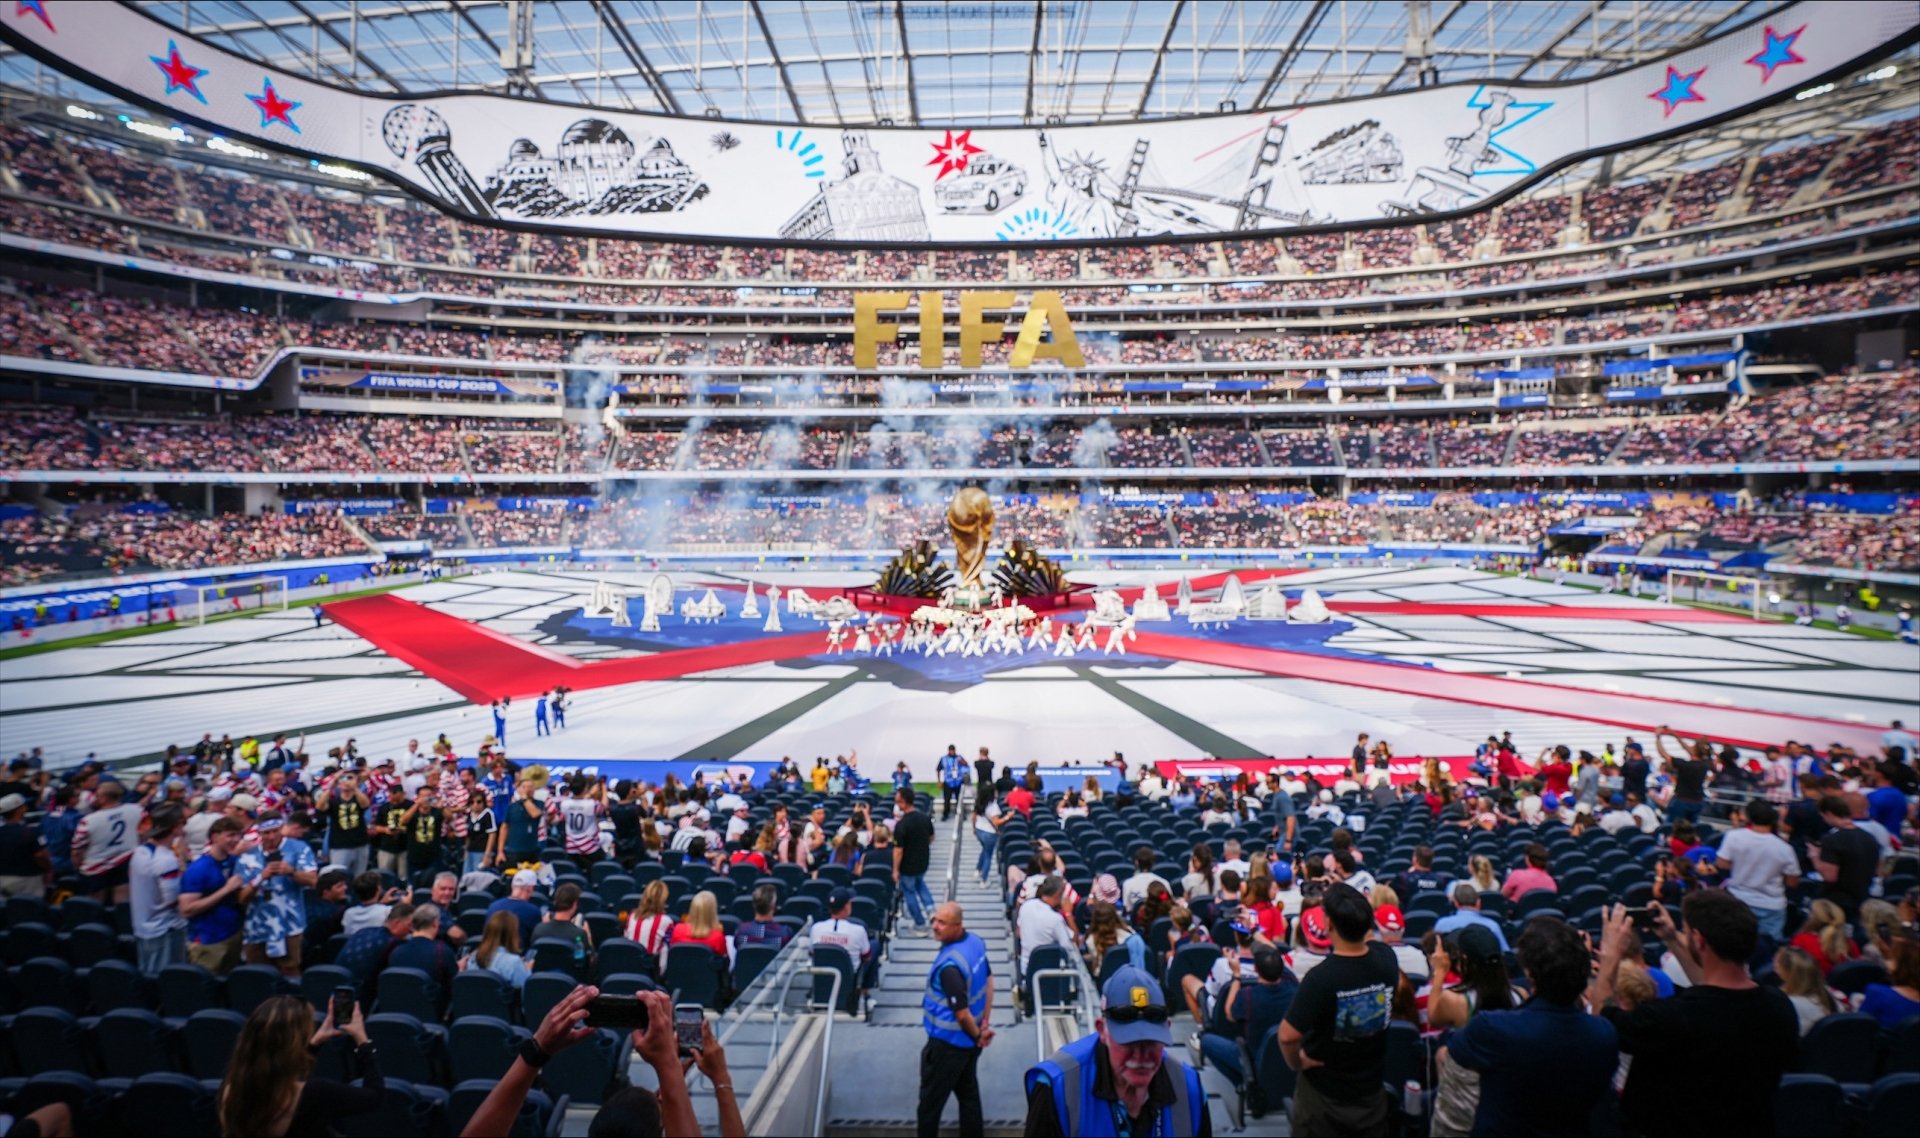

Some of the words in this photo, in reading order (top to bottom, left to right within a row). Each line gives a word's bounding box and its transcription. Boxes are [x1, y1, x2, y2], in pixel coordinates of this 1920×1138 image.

[853, 290, 1086, 369] FIFA
[370, 375, 396, 387] FIFA
[396, 377, 437, 389] WORLD
[437, 379, 459, 390] CUP
[460, 381, 498, 392] 2026
[939, 384, 961, 393] LOS
[570, 812, 585, 831] 10
[108, 820, 126, 847] 2
